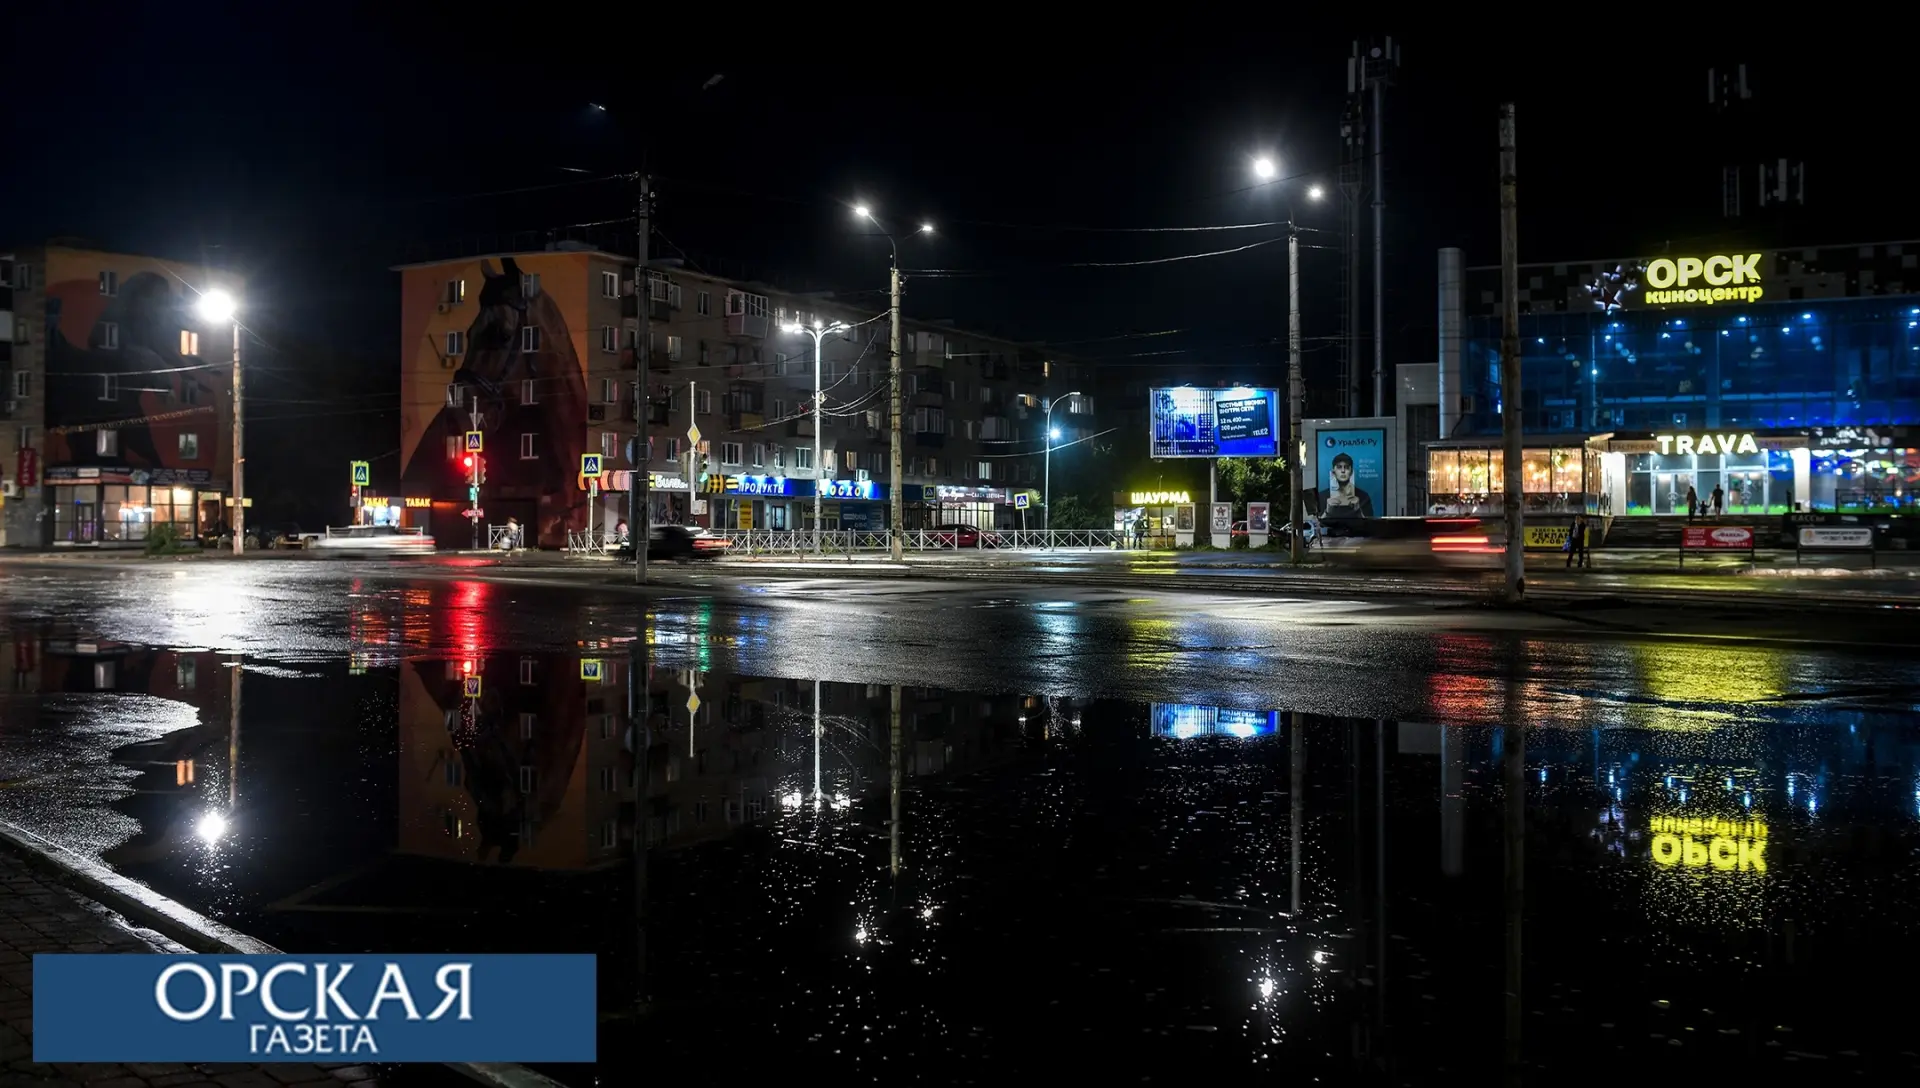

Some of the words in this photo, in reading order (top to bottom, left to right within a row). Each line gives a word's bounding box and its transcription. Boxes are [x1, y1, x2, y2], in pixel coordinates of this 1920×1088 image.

[1646, 253, 1762, 289] ОРСК
[1645, 286, 1764, 305] киноцентр
[1657, 434, 1759, 456] TRAVA
[738, 480, 785, 495] ПРОДУКТЫ
[821, 483, 869, 500] ОСХОД
[364, 498, 389, 508] ТАБАК
[405, 498, 431, 508] ТАБАК
[1131, 491, 1190, 504] ШАУРМА
